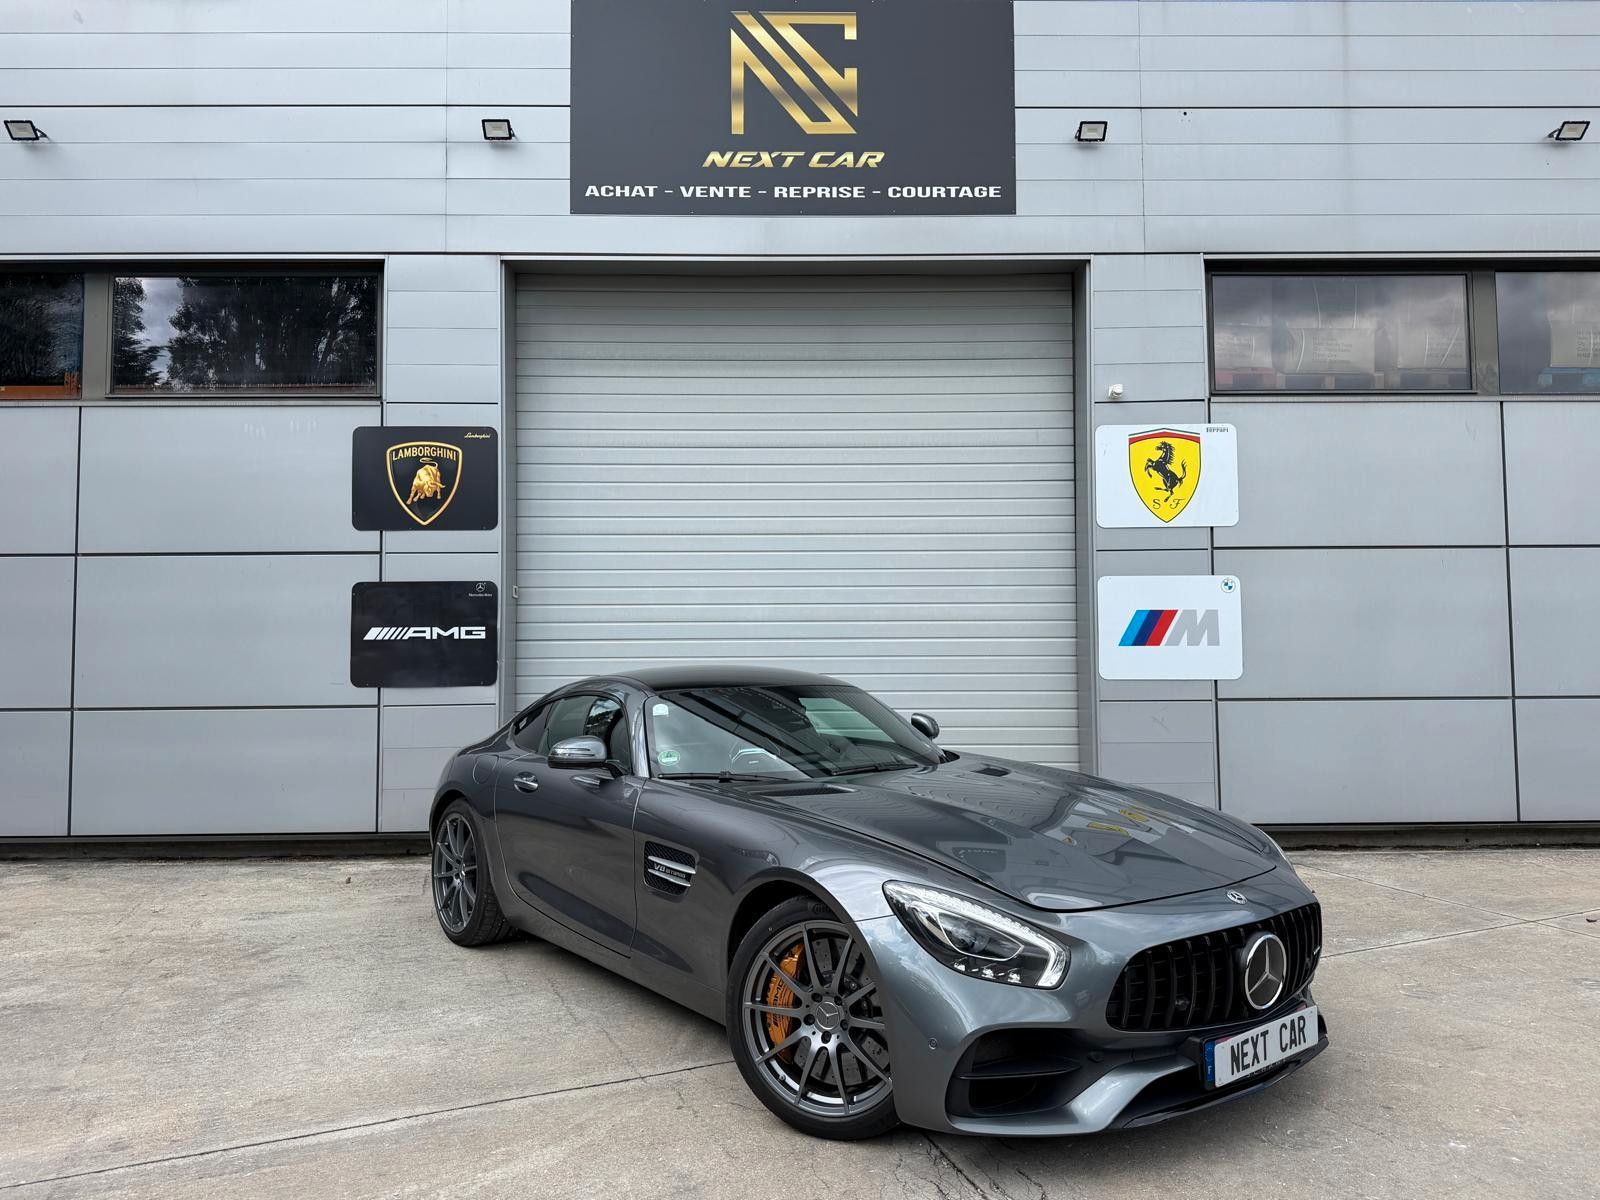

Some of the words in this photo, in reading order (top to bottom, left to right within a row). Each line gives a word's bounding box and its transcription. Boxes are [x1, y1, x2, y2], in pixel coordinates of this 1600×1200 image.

[702, 151, 805, 168] NEXT
[808, 151, 886, 168] CAR
[585, 185, 658, 198] ACHAT
[680, 185, 752, 198] VENTE
[773, 186, 866, 199] REPRISE
[887, 186, 1002, 199] COURTAGE
[392, 446, 457, 461] LAMBORGHINI
[1152, 498, 1161, 510] S
[401, 626, 486, 640] AMG
[1163, 609, 1220, 646] M
[1230, 1029, 1269, 1076] NEXT
[1279, 1015, 1307, 1053] CAR
